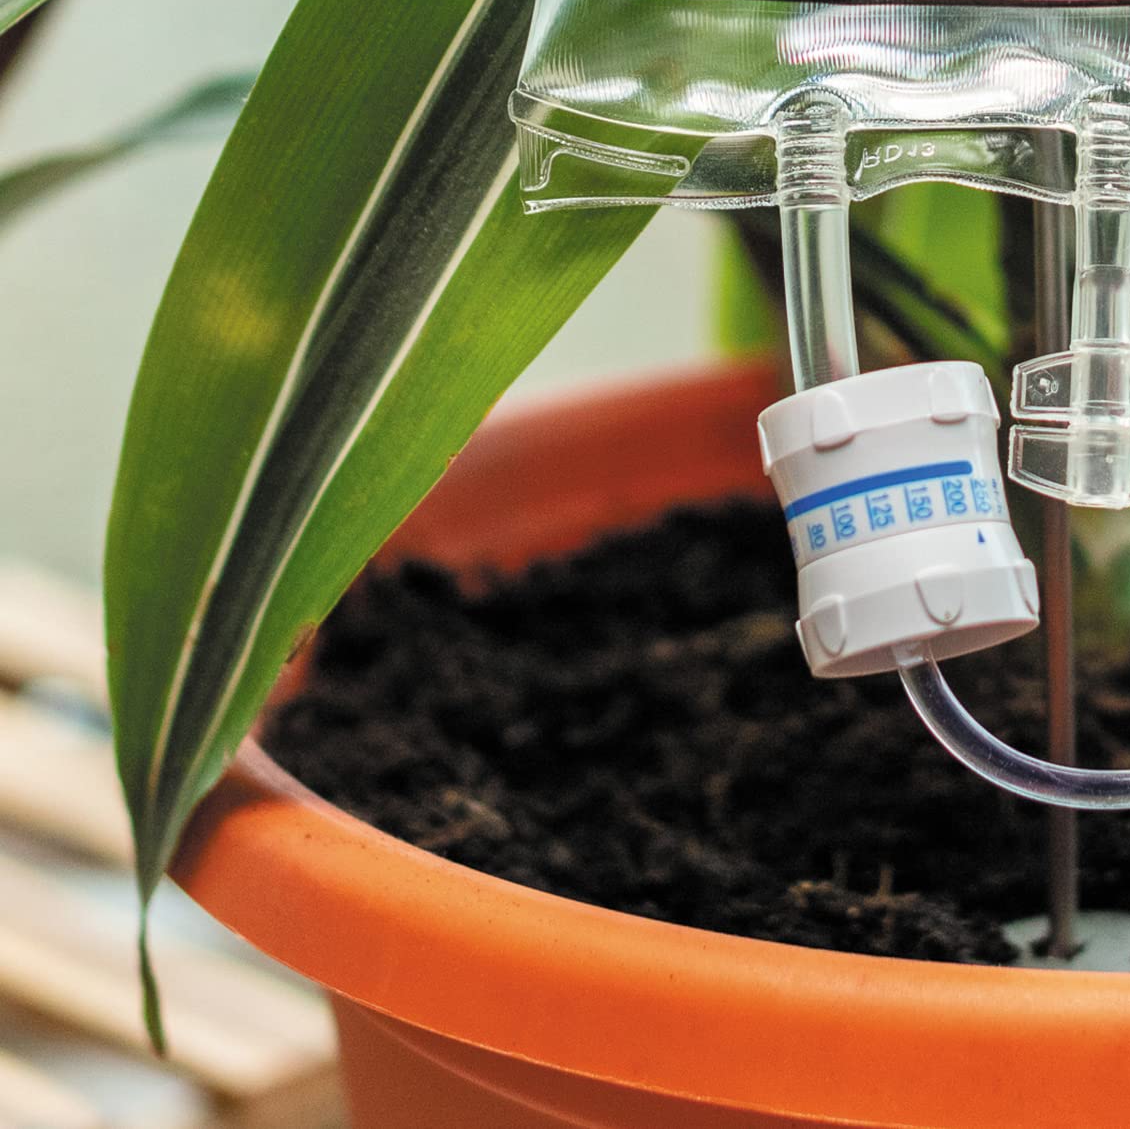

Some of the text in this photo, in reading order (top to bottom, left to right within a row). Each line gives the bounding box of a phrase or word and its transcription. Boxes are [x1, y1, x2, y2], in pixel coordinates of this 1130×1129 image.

[872, 493, 895, 528] 125
[911, 486, 934, 521] 150
[949, 478, 968, 515] 200
[974, 478, 992, 514] 250
[812, 523, 827, 549] 80
[836, 504, 857, 539] 100
